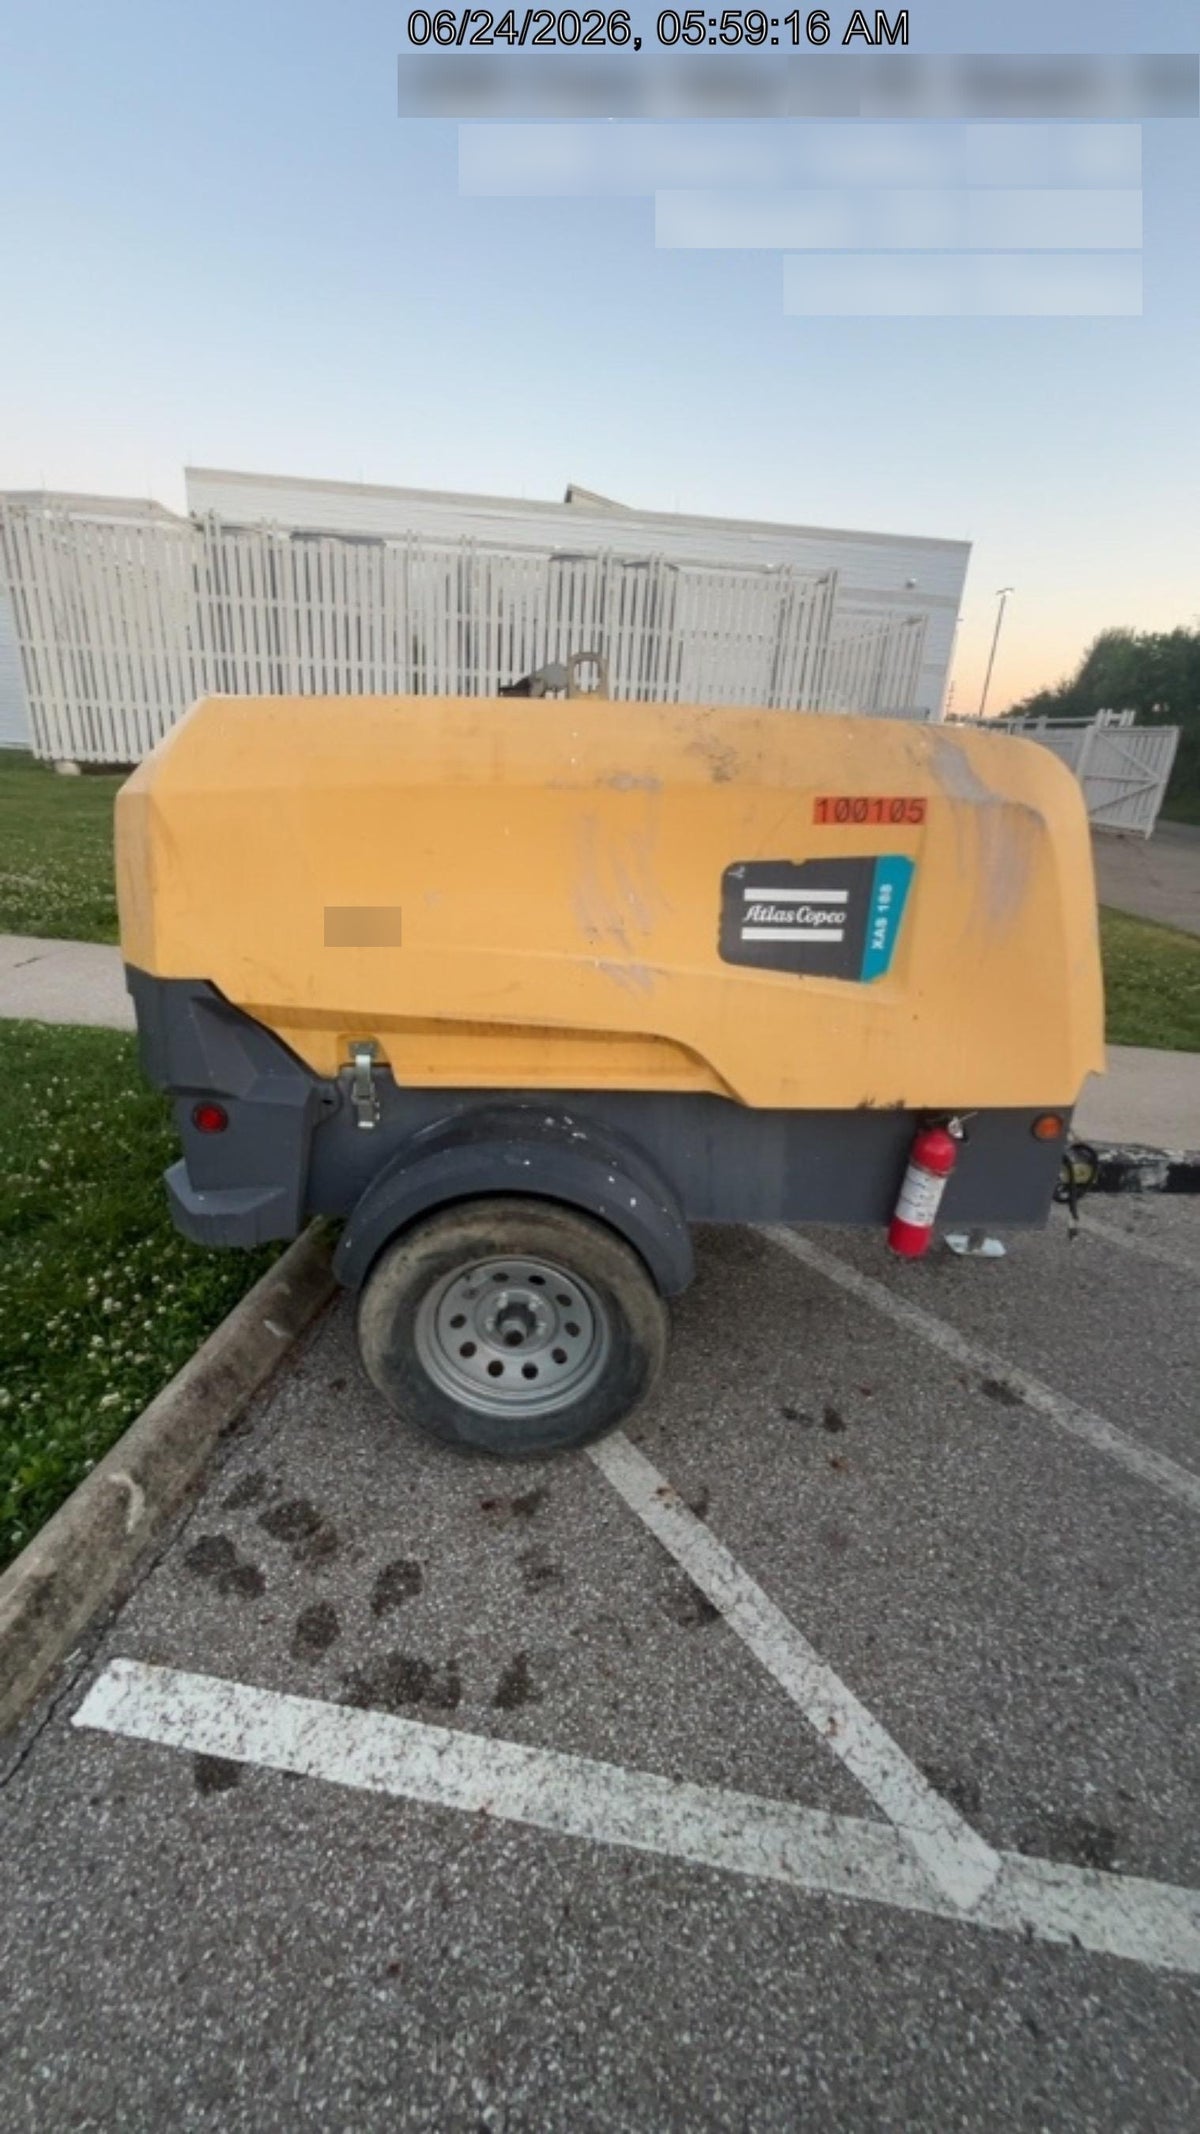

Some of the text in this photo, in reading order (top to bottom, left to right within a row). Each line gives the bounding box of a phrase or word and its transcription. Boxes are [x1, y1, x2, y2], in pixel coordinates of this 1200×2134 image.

[817, 799, 925, 823] 100105
[743, 904, 846, 926] Atlas Copco
[871, 918, 888, 949] XAS
